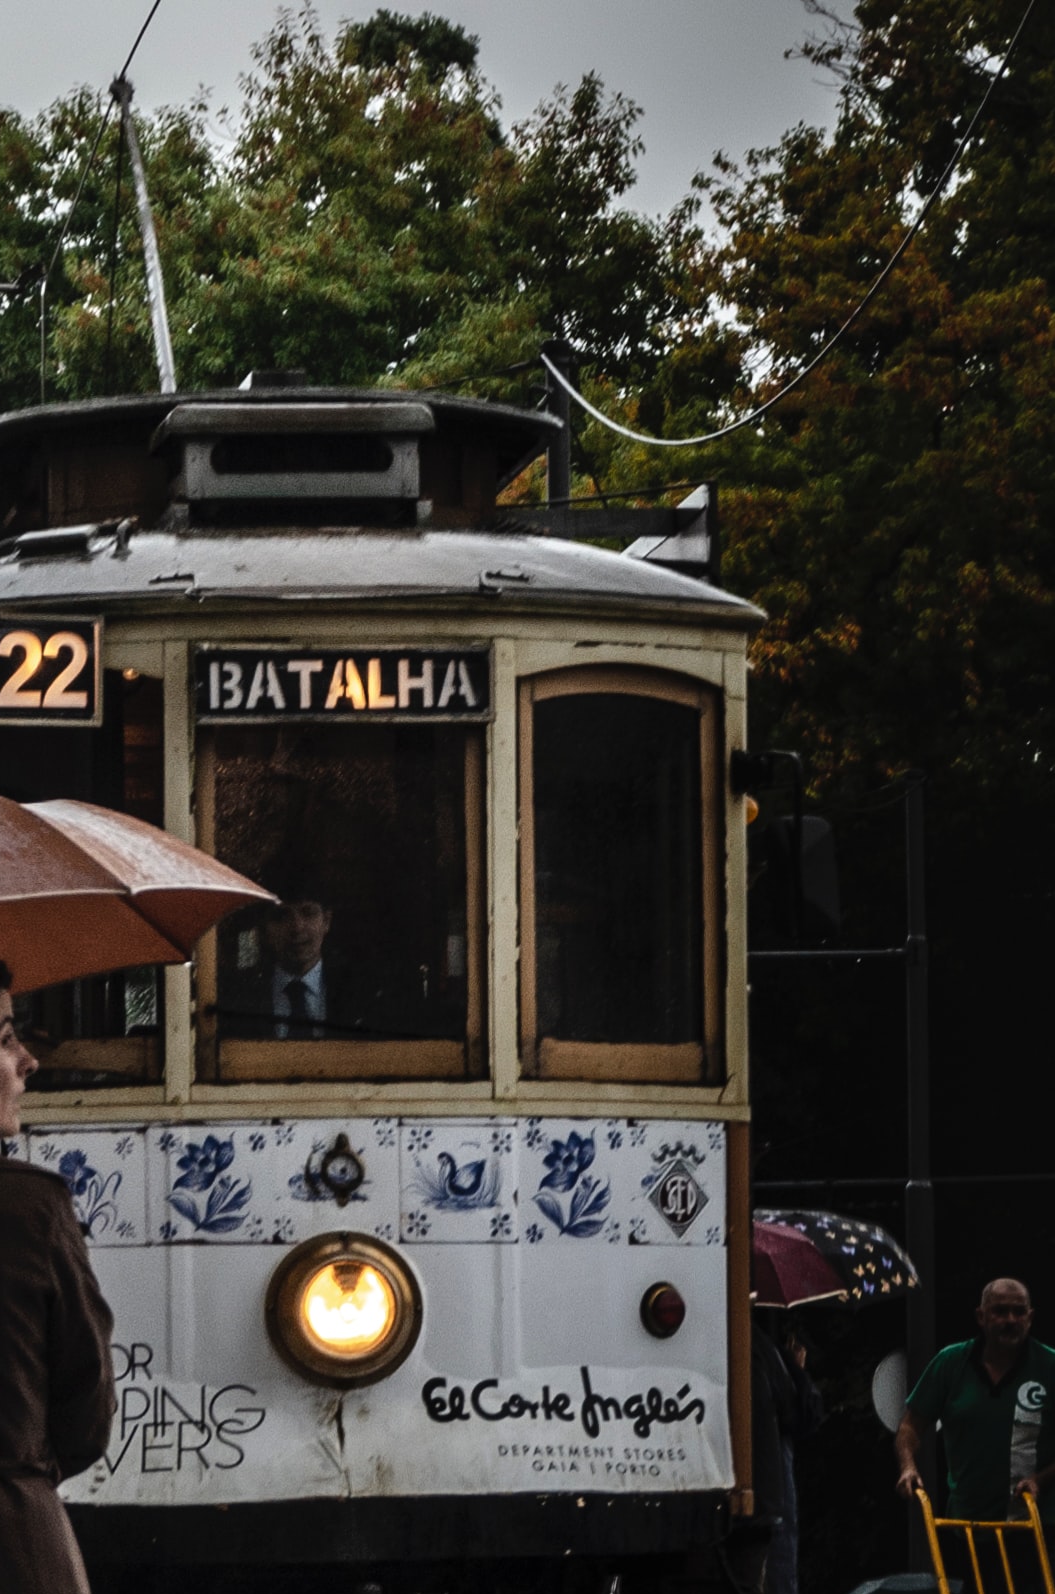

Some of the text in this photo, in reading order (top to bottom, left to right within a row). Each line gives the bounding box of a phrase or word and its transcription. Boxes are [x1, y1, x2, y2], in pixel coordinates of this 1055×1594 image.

[209, 658, 478, 710] BATALHA
[113, 1384, 266, 1441] PING
[422, 1366, 705, 1438] El Corte Inglés
[498, 1444, 686, 1461] DEPARTMENT STORES
[532, 1459, 579, 1472] GAIA
[605, 1461, 661, 1477] PORTO
